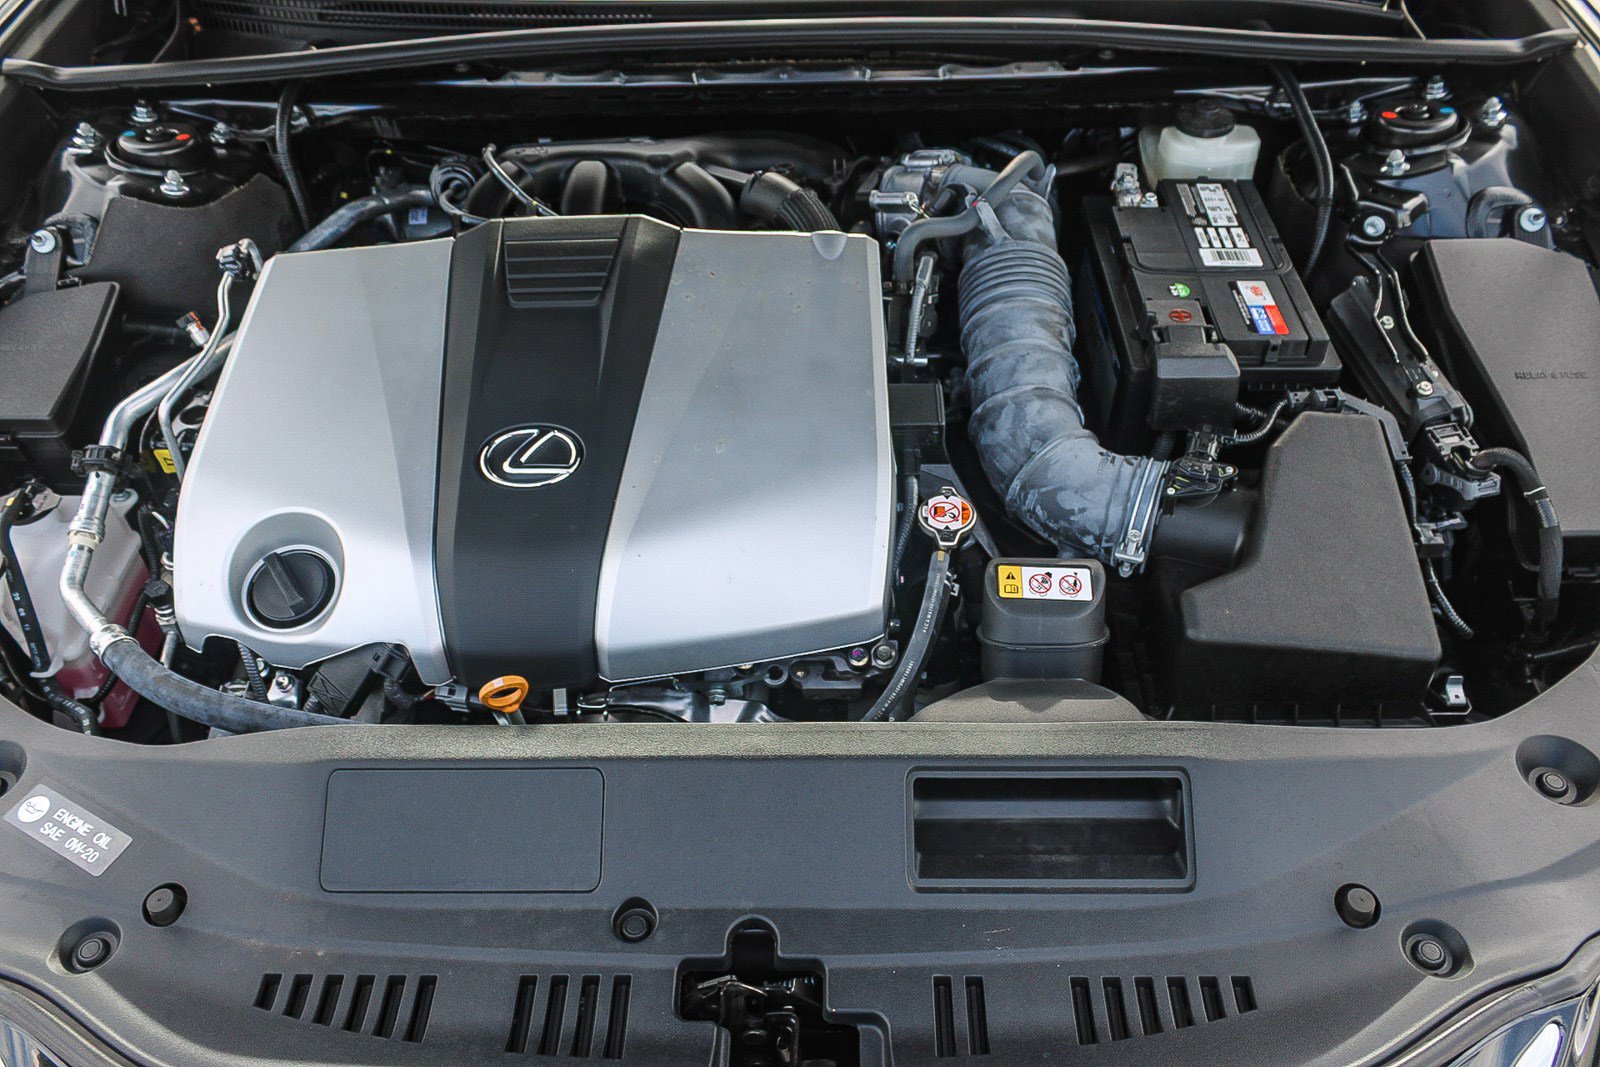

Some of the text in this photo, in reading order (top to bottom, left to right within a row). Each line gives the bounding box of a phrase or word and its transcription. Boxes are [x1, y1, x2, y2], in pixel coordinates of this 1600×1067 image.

[39, 821, 100, 863] SAE 0W-20
[52, 808, 112, 850] ENGINE OIL
